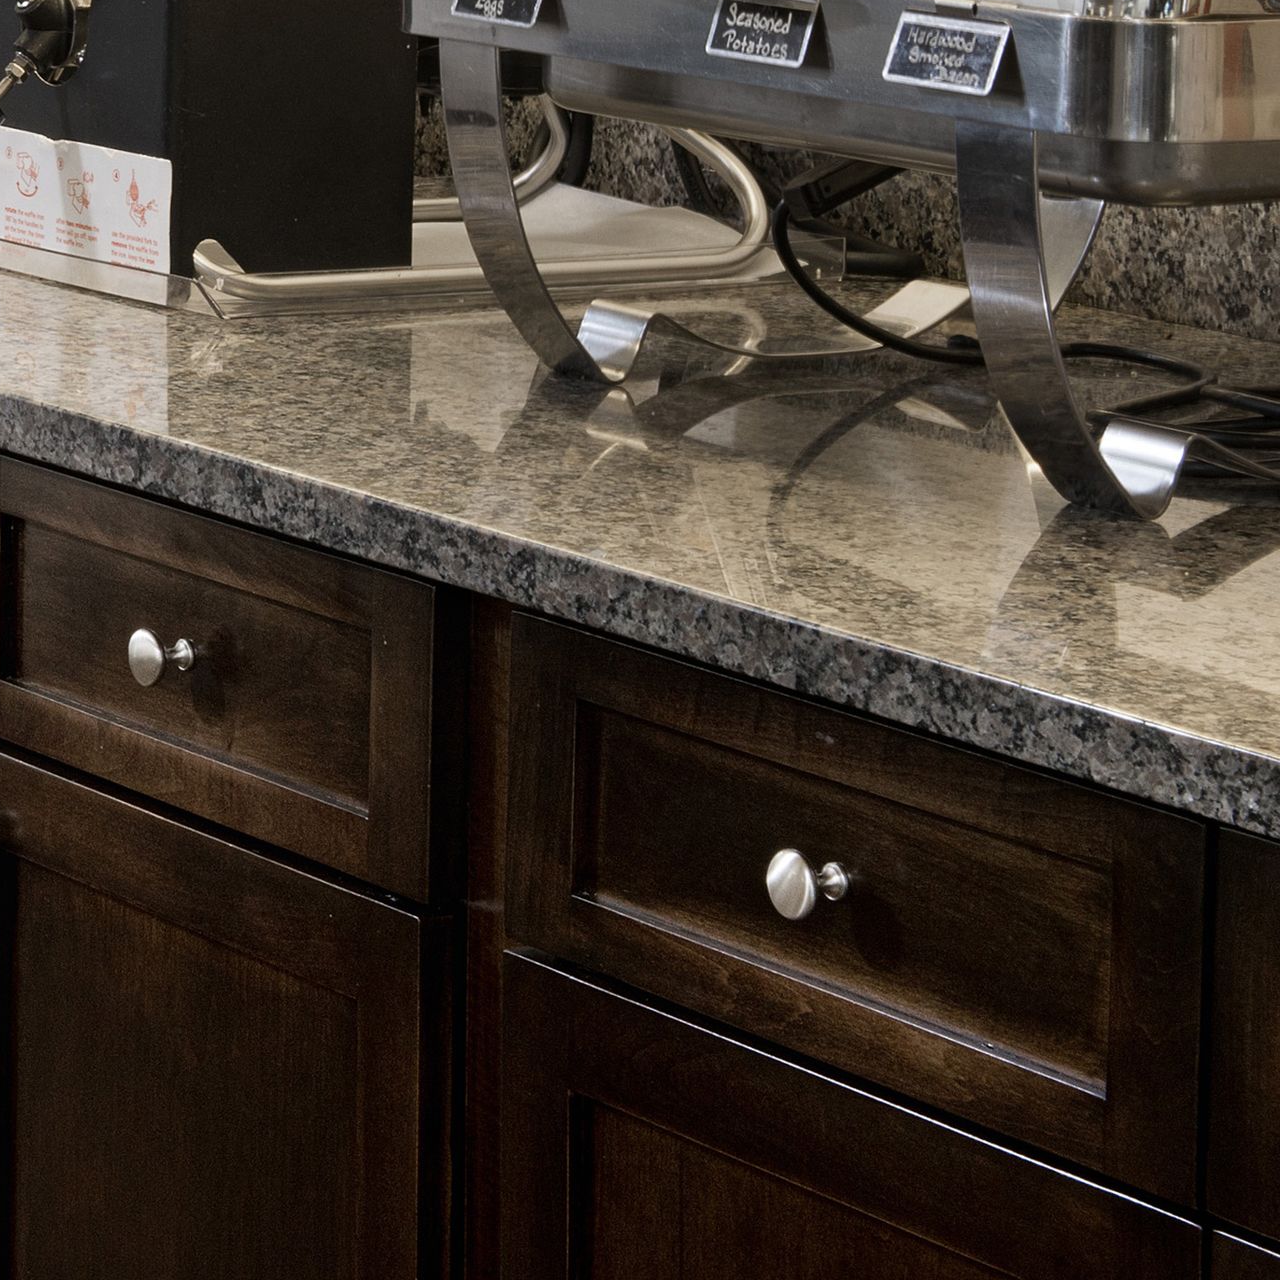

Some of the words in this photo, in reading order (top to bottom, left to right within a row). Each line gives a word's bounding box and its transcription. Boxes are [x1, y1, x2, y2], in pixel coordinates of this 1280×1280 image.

[726, 2, 792, 34] Seasoned
[722, 29, 789, 60] Potatoes
[907, 26, 976, 53] Hardwood
